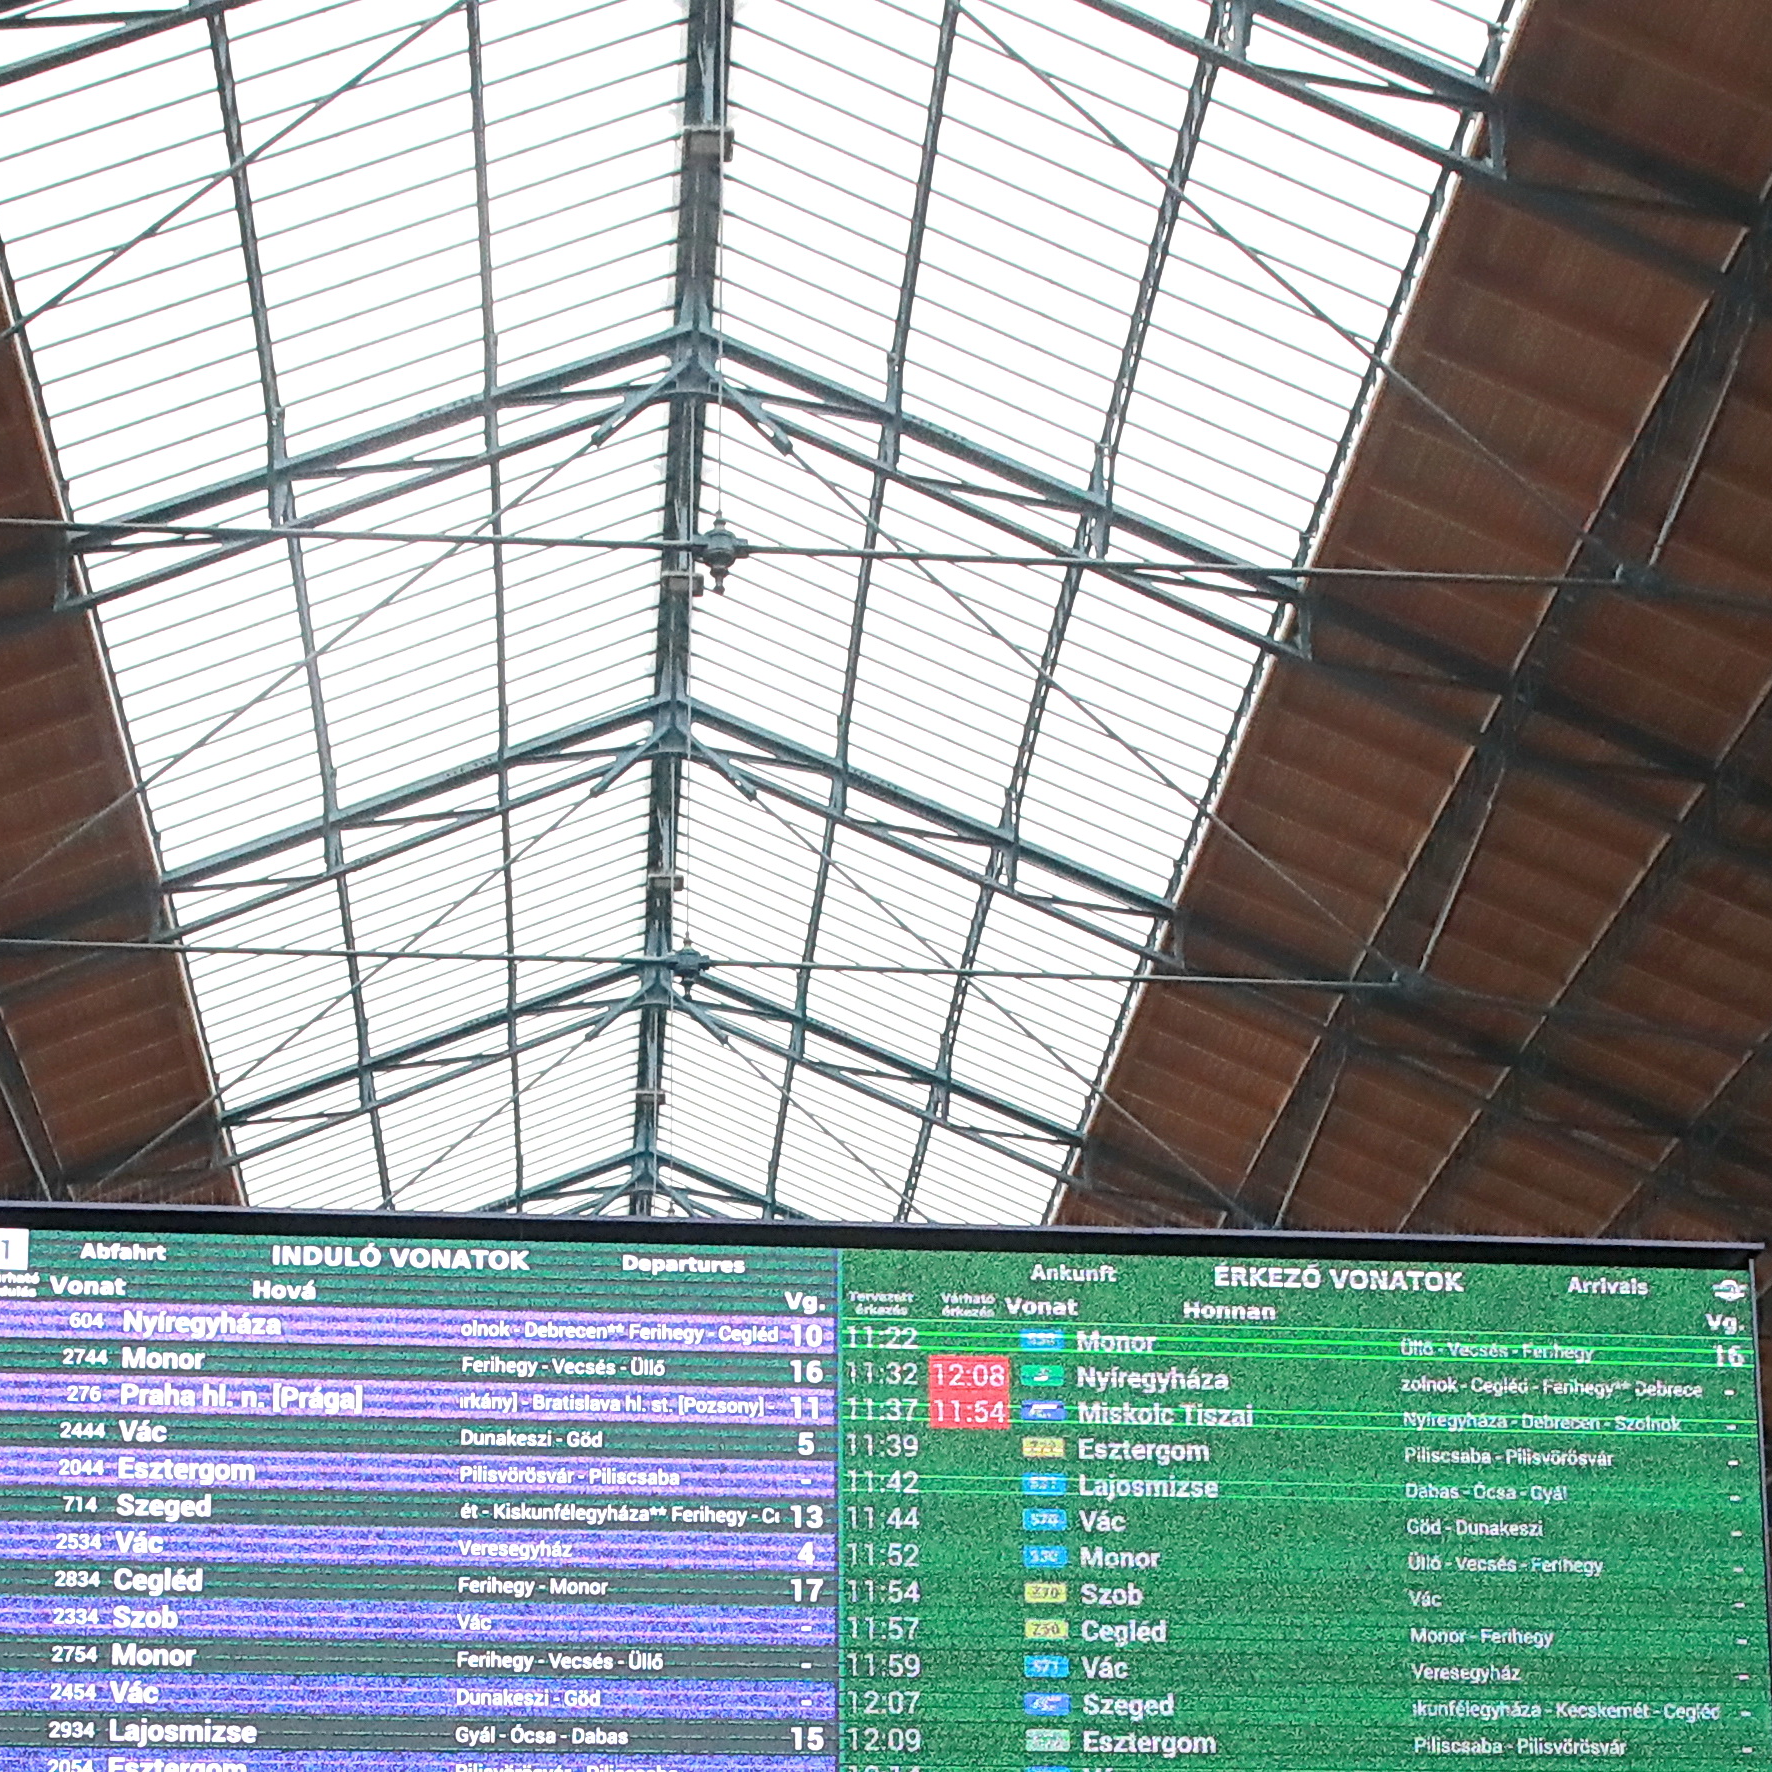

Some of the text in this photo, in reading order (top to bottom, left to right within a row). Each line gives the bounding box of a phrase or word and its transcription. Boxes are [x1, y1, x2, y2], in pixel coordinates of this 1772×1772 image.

[81, 1243, 166, 1261] Abfahrt
[272, 1239, 381, 1269] INDULÓ
[390, 1246, 530, 1271] VONATOK
[623, 1255, 745, 1275] Departures
[50, 1276, 825, 1314] Vonat Hová Vg.
[1030, 1263, 1648, 1295] Ankunft ÉRKEZŐ VONATOK Arrivals
[1005, 1297, 1077, 1317] Vonat
[1183, 1302, 1275, 1320] Honnan
[70, 1313, 104, 1329] 604
[123, 1309, 281, 1338] Nyíregyháza
[630, 1323, 705, 1344] Ferihegy
[719, 1325, 778, 1344] Cegléd
[790, 1325, 822, 1348] 10
[63, 1349, 107, 1366] 2744
[122, 1348, 204, 1369] Monor
[462, 1356, 537, 1377] Ferihegy
[554, 1359, 615, 1376] Vecsés
[631, 1357, 665, 1376] Üllő
[790, 1360, 823, 1382] 16
[933, 1364, 1229, 1392] 12:08 Nyíregyháza
[67, 1386, 101, 1402] 276
[120, 1384, 196, 1407] Praha
[203, 1384, 232, 1407] hl.
[242, 1390, 263, 1407] n.
[273, 1386, 363, 1414] [Prága]
[533, 1394, 620, 1412] Bratislava
[626, 1395, 646, 1412] hl.
[652, 1397, 673, 1413] st.
[679, 1397, 763, 1418] [Pozsony]
[790, 1397, 818, 1419] 11
[933, 1401, 1005, 1424] 11:54
[1078, 1404, 1173, 1426] Miskolc
[1181, 1404, 1253, 1426] Tiszai
[60, 1423, 105, 1438] 2444
[119, 1419, 167, 1442] Vác
[460, 1430, 551, 1446] Dunakeszi
[567, 1431, 603, 1447] Göd
[798, 1433, 814, 1455] 5
[847, 1436, 1209, 1466] 11:39 Esztergom
[64, 1496, 96, 1512] 714
[117, 1494, 211, 1521] Szeged
[672, 1506, 747, 1526] Ferihegy
[790, 1505, 823, 1528] 13
[56, 1533, 101, 1550] 2534
[115, 1530, 163, 1554] Vác
[458, 1540, 572, 1561] Veresegyház
[798, 1543, 815, 1565] 4
[55, 1571, 99, 1588] 2834
[114, 1568, 203, 1595] Cegléd
[458, 1578, 535, 1598] Ferihegy
[550, 1579, 607, 1596] Monor
[791, 1579, 823, 1602] 17
[847, 1580, 1143, 1606] 11:54 Szob
[53, 1608, 99, 1624] 2334
[113, 1605, 178, 1629] Szob
[457, 1614, 491, 1630] Vác
[847, 1617, 1167, 1647] 11:57 Cegléd
[847, 1654, 1521, 1685] 11:59 Vác Veresegyház
[49, 1722, 95, 1738] 2934
[109, 1720, 257, 1747] Lajosmizse
[455, 1726, 495, 1745] Gyál
[511, 1726, 555, 1745] Ócsa
[572, 1728, 629, 1745] Dabas
[791, 1728, 824, 1750] 15
